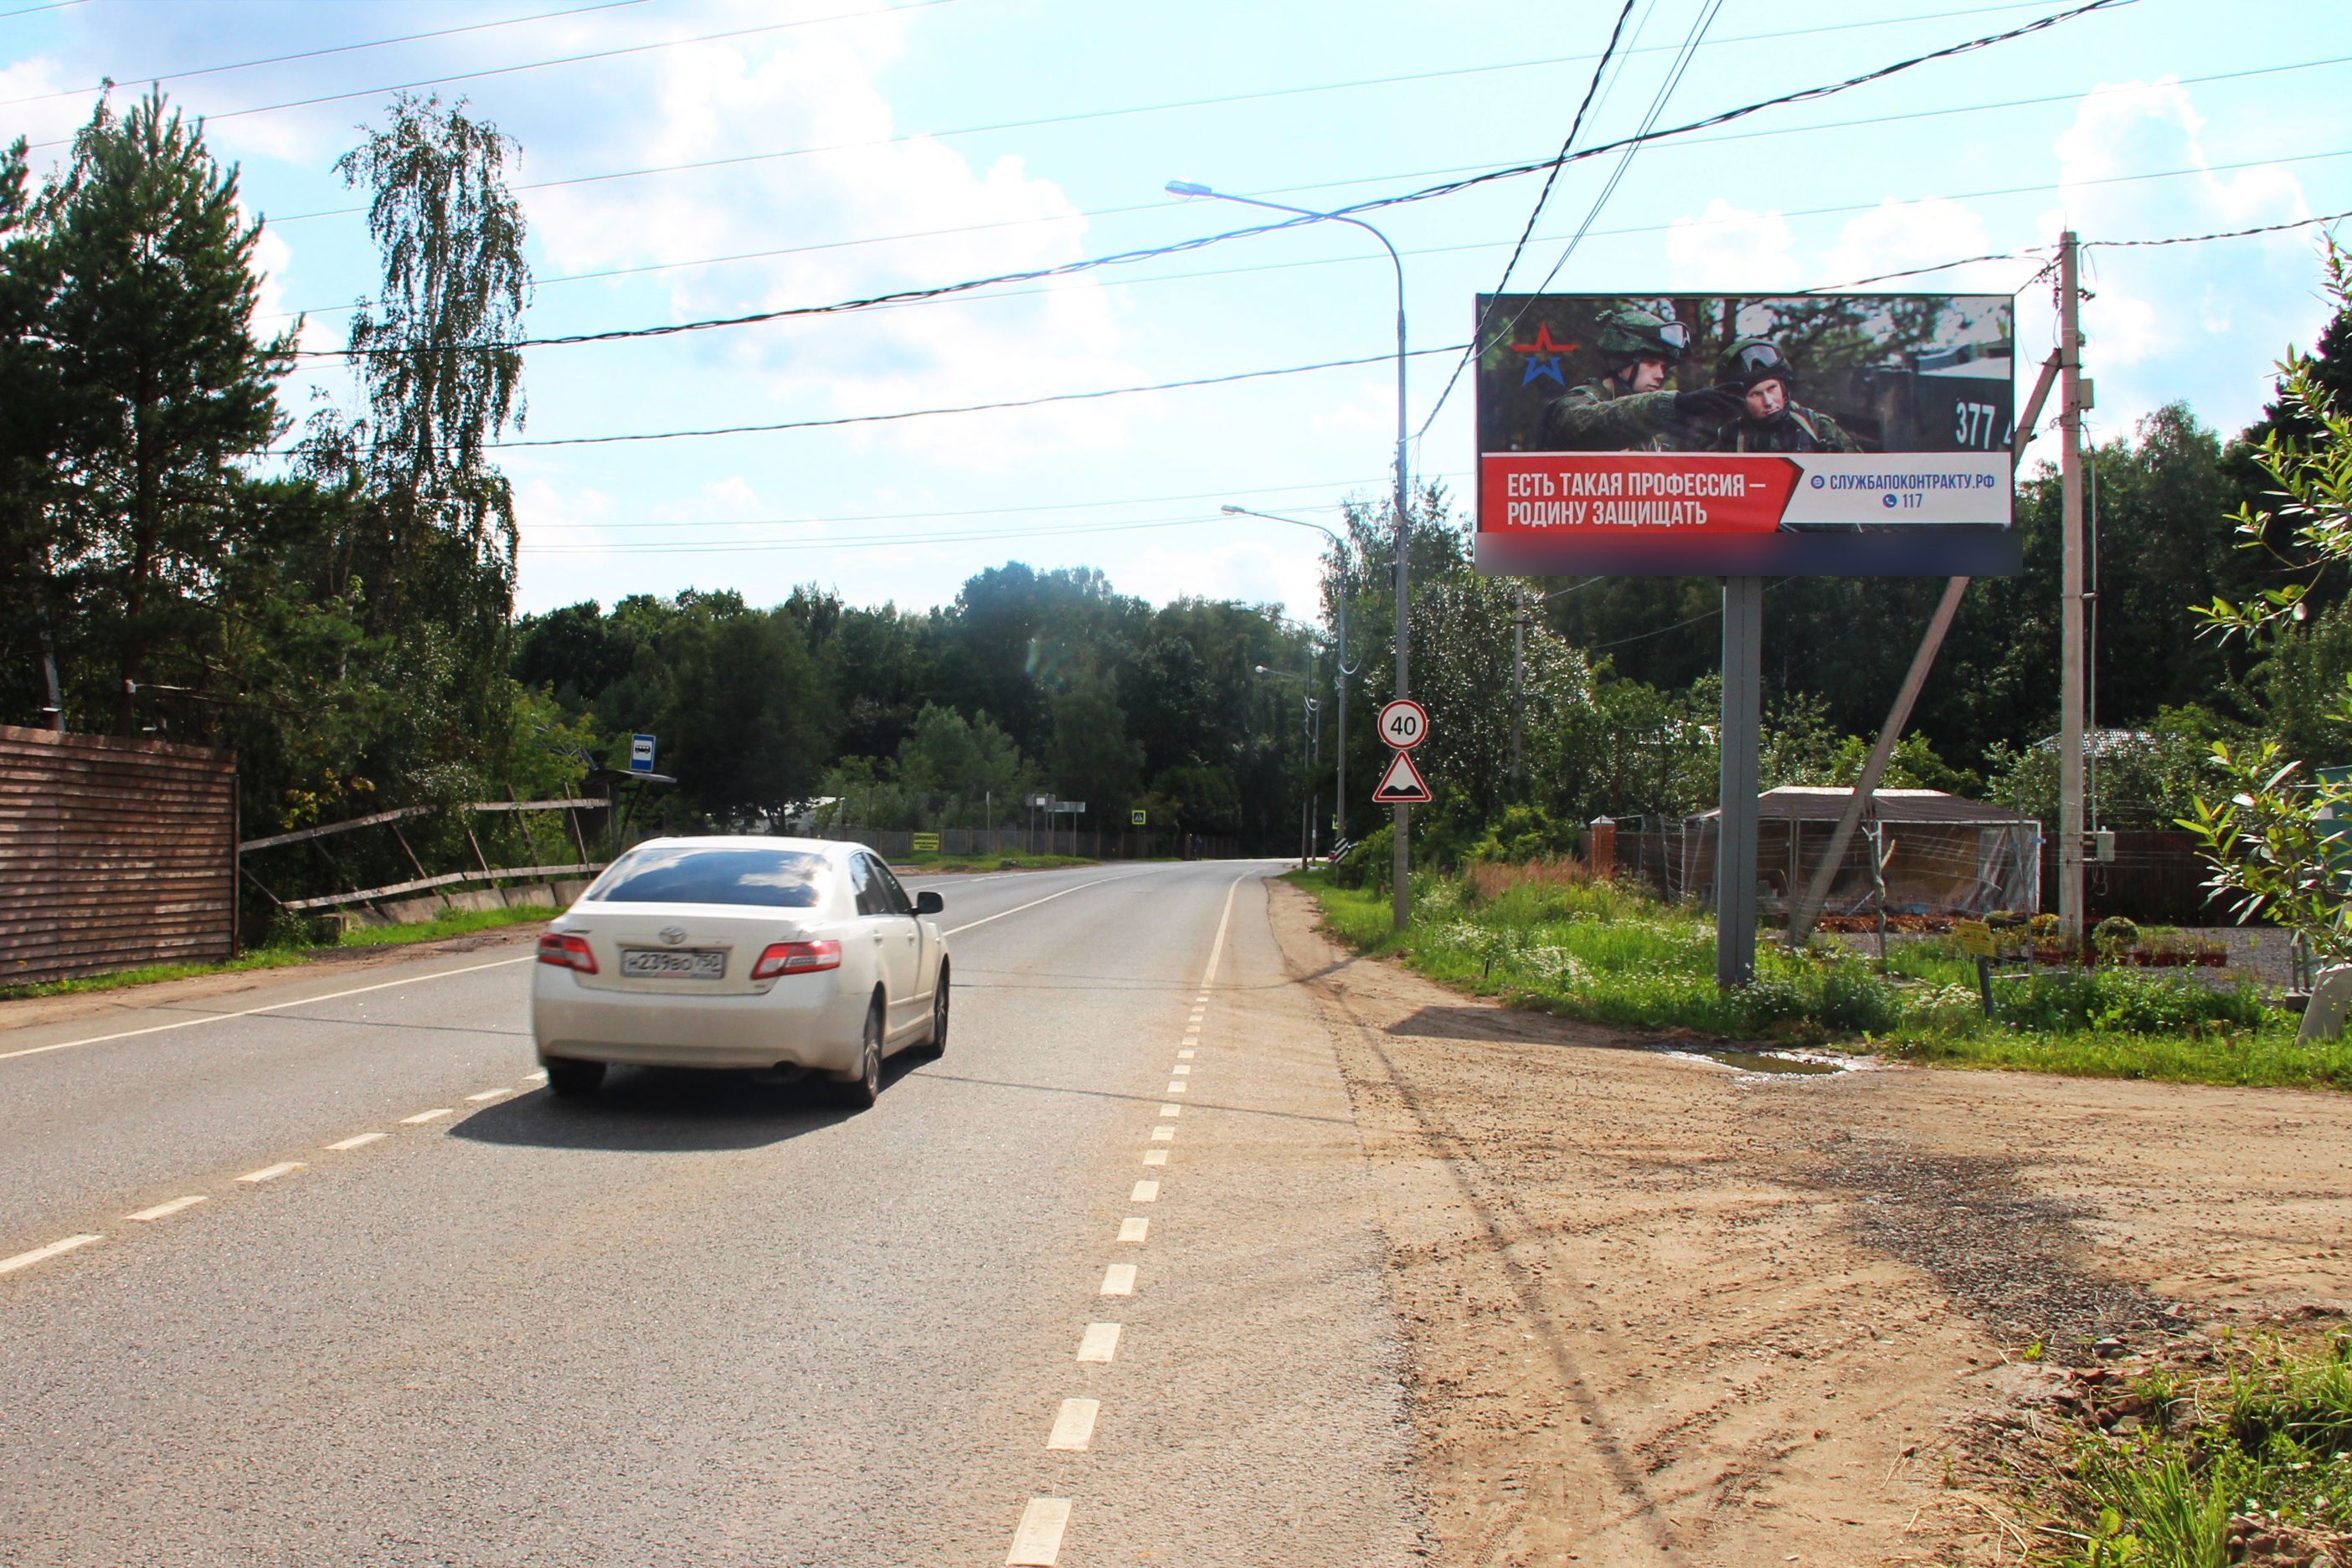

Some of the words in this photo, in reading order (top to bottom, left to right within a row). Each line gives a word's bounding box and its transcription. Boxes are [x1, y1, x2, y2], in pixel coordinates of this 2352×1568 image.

[1956, 402, 1995, 450] 377
[1507, 473, 1555, 497] ЕСТЬ
[1559, 473, 1623, 496] ТАКАЯ
[1628, 472, 1745, 497] ПРОФЕССИЯ
[1830, 474, 1995, 490] СЛУЖБАПОКОНТРАКТУ.РФ
[1902, 494, 1923, 508] 117
[1507, 501, 1587, 527] РОДИНУ
[1593, 501, 1707, 527] ЗАЩИЩАТЬ
[1390, 716, 1417, 736] 40
